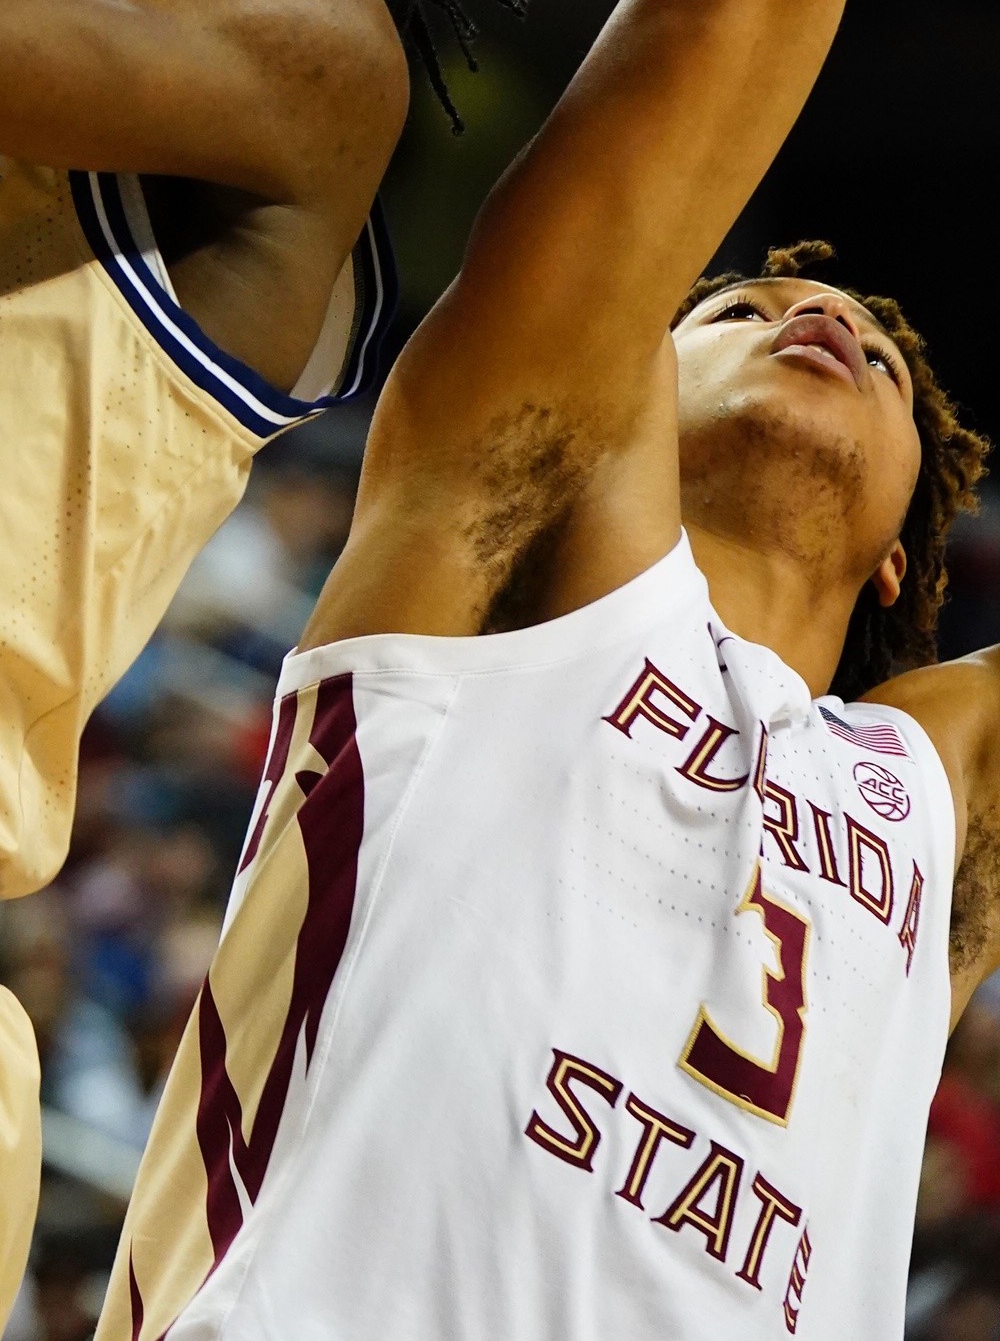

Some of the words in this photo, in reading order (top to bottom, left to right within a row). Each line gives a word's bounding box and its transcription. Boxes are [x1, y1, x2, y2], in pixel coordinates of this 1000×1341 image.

[861, 777, 906, 801] ACC
[676, 855, 812, 1129] 3
[524, 1047, 813, 1335] STATE
